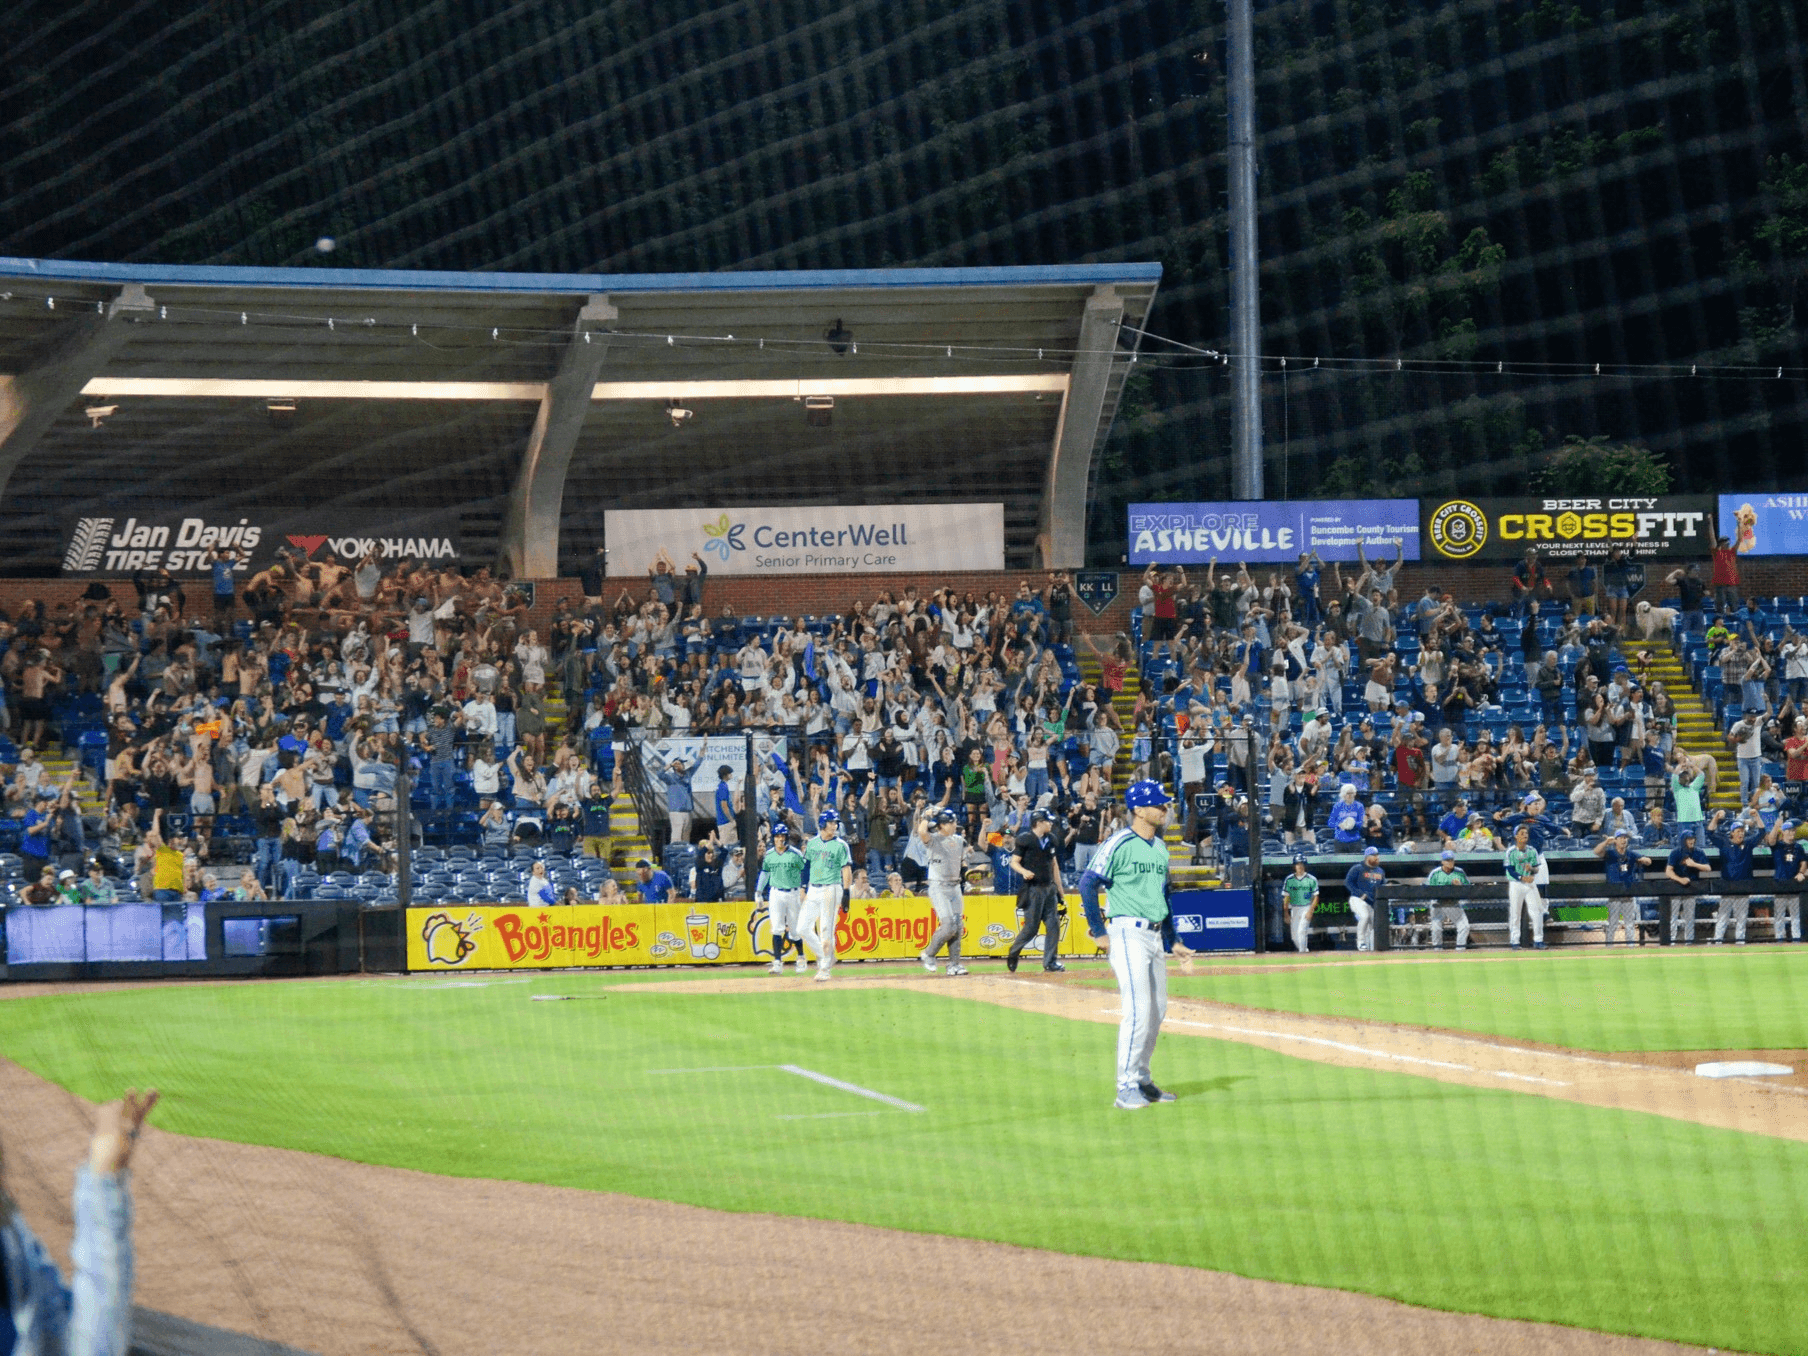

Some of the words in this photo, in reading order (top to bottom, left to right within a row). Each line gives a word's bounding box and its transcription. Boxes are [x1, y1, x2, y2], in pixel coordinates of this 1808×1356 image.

[1542, 499, 1602, 510] BEER
[1609, 498, 1658, 510] CITY
[111, 518, 170, 547] Jan
[175, 518, 262, 547] Davis
[1130, 513, 1260, 533] EXPLORE
[1311, 525, 1354, 534] Buncombe
[1356, 524, 1385, 535] County
[1386, 523, 1419, 533] Tourism
[1433, 518, 1443, 540] BEER
[1440, 504, 1458, 518] CITY
[1460, 504, 1484, 541] CROSSFIT
[1499, 511, 1703, 540] CROSSFIT
[753, 523, 908, 548] CenterWell
[1134, 527, 1294, 553] ASHEVILLE
[327, 538, 457, 558] YOKOHAMA
[105, 550, 164, 571] TIRE
[164, 550, 253, 571] STOE
[755, 554, 800, 568] Senior
[805, 553, 859, 568] Primary
[863, 553, 896, 566] Care
[1080, 582, 1094, 591] KK
[1102, 582, 1113, 591] LL
[493, 911, 639, 962] Bojangles
